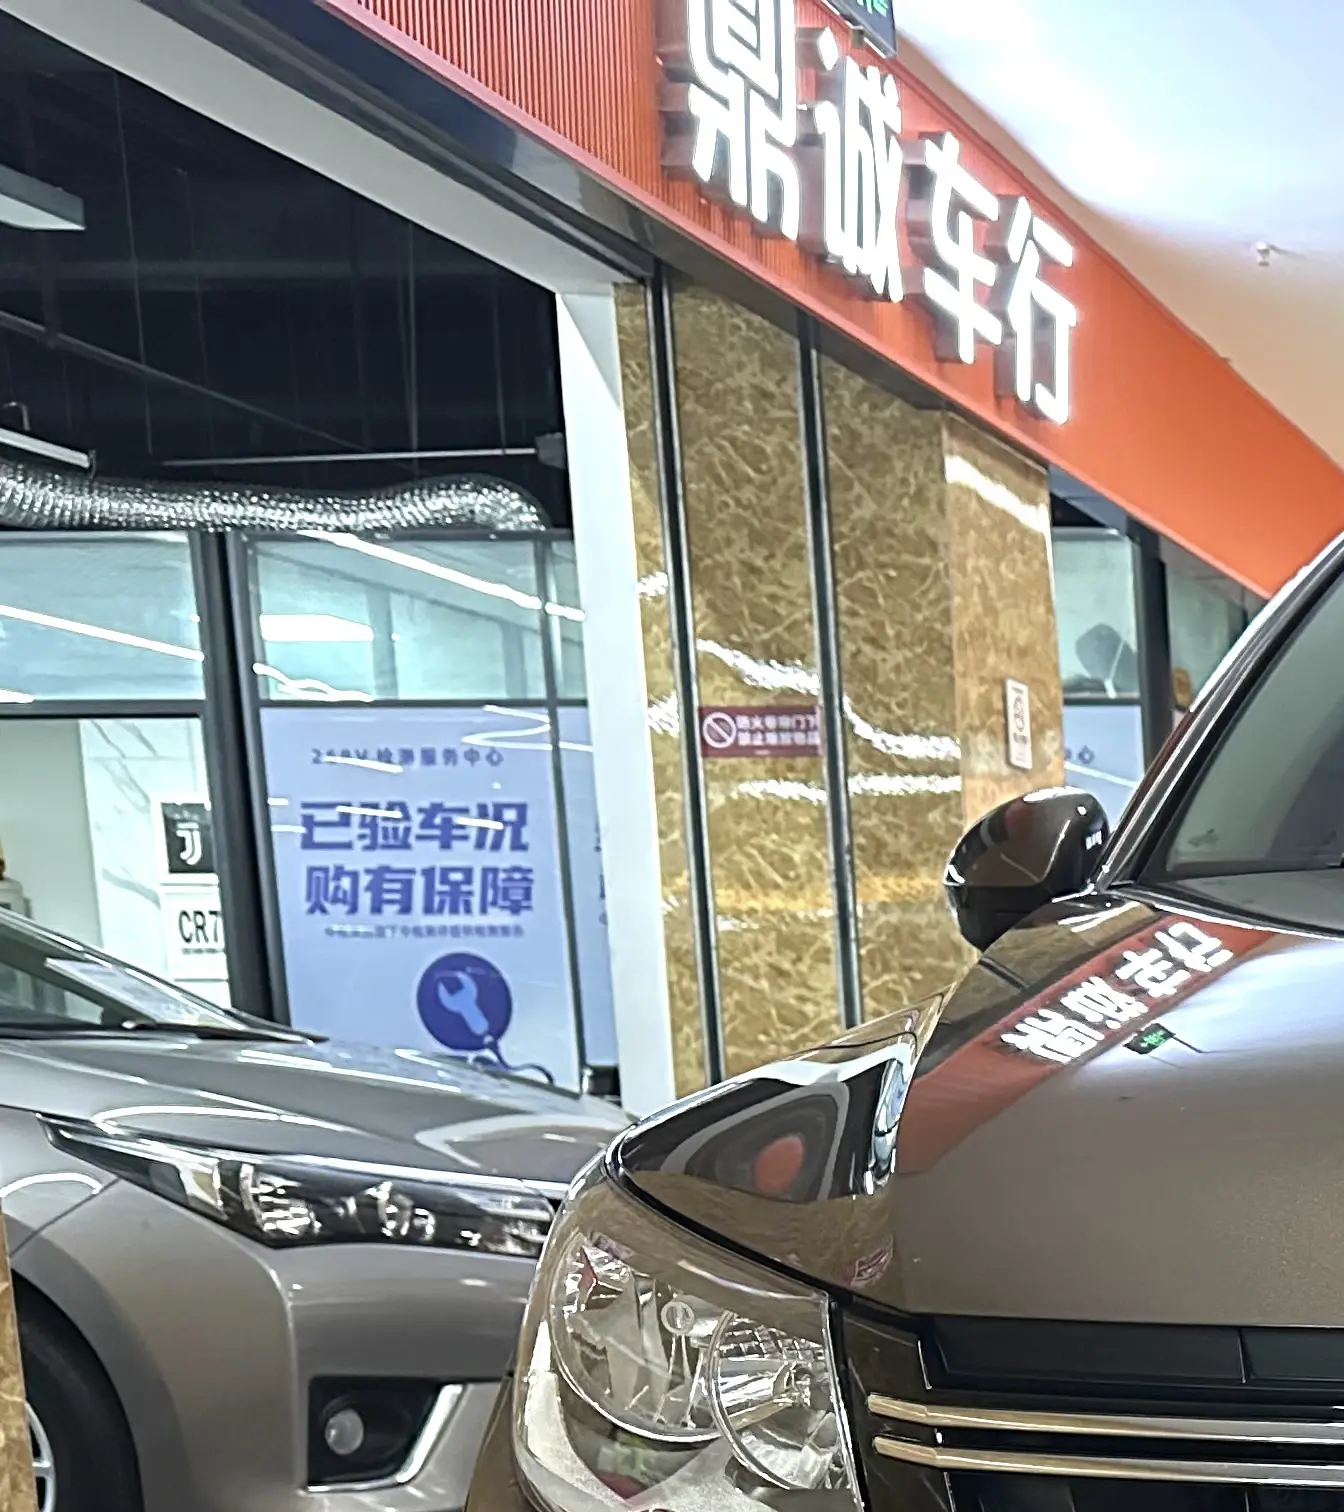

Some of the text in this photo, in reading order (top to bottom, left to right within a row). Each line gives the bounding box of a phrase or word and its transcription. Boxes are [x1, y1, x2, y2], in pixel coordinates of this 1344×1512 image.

[687, 0, 1078, 425] 鼎诚车行
[301, 801, 529, 853] 已验车况
[305, 864, 534, 916] 购有保障
